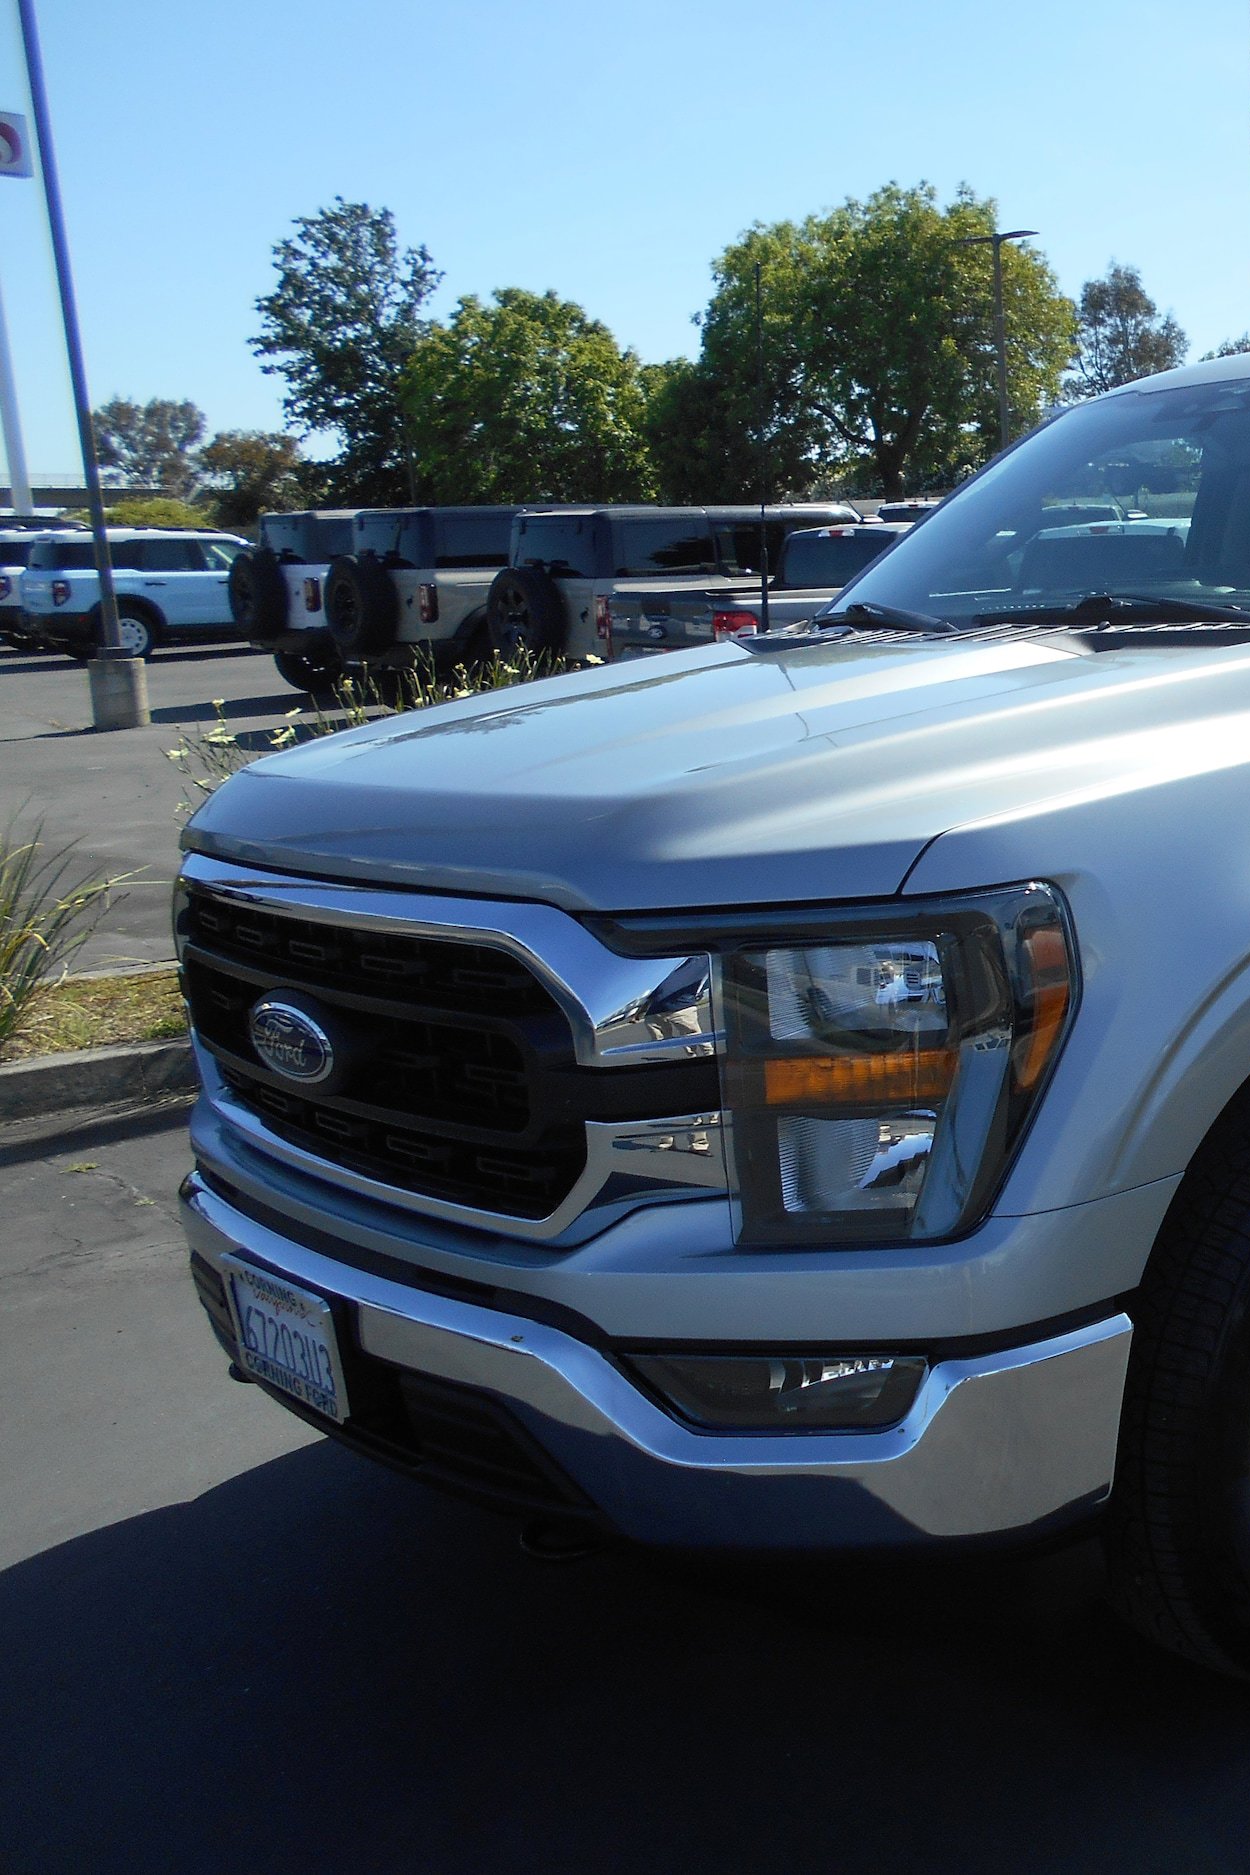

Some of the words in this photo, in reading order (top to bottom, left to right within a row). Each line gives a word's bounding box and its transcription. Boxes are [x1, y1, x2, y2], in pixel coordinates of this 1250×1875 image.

[254, 1018, 307, 1067] Ford
[244, 1270, 298, 1306] CORNING
[243, 1305, 337, 1396] 67203U3
[245, 1351, 303, 1397] CORNING
[305, 1385, 338, 1418] FORD
